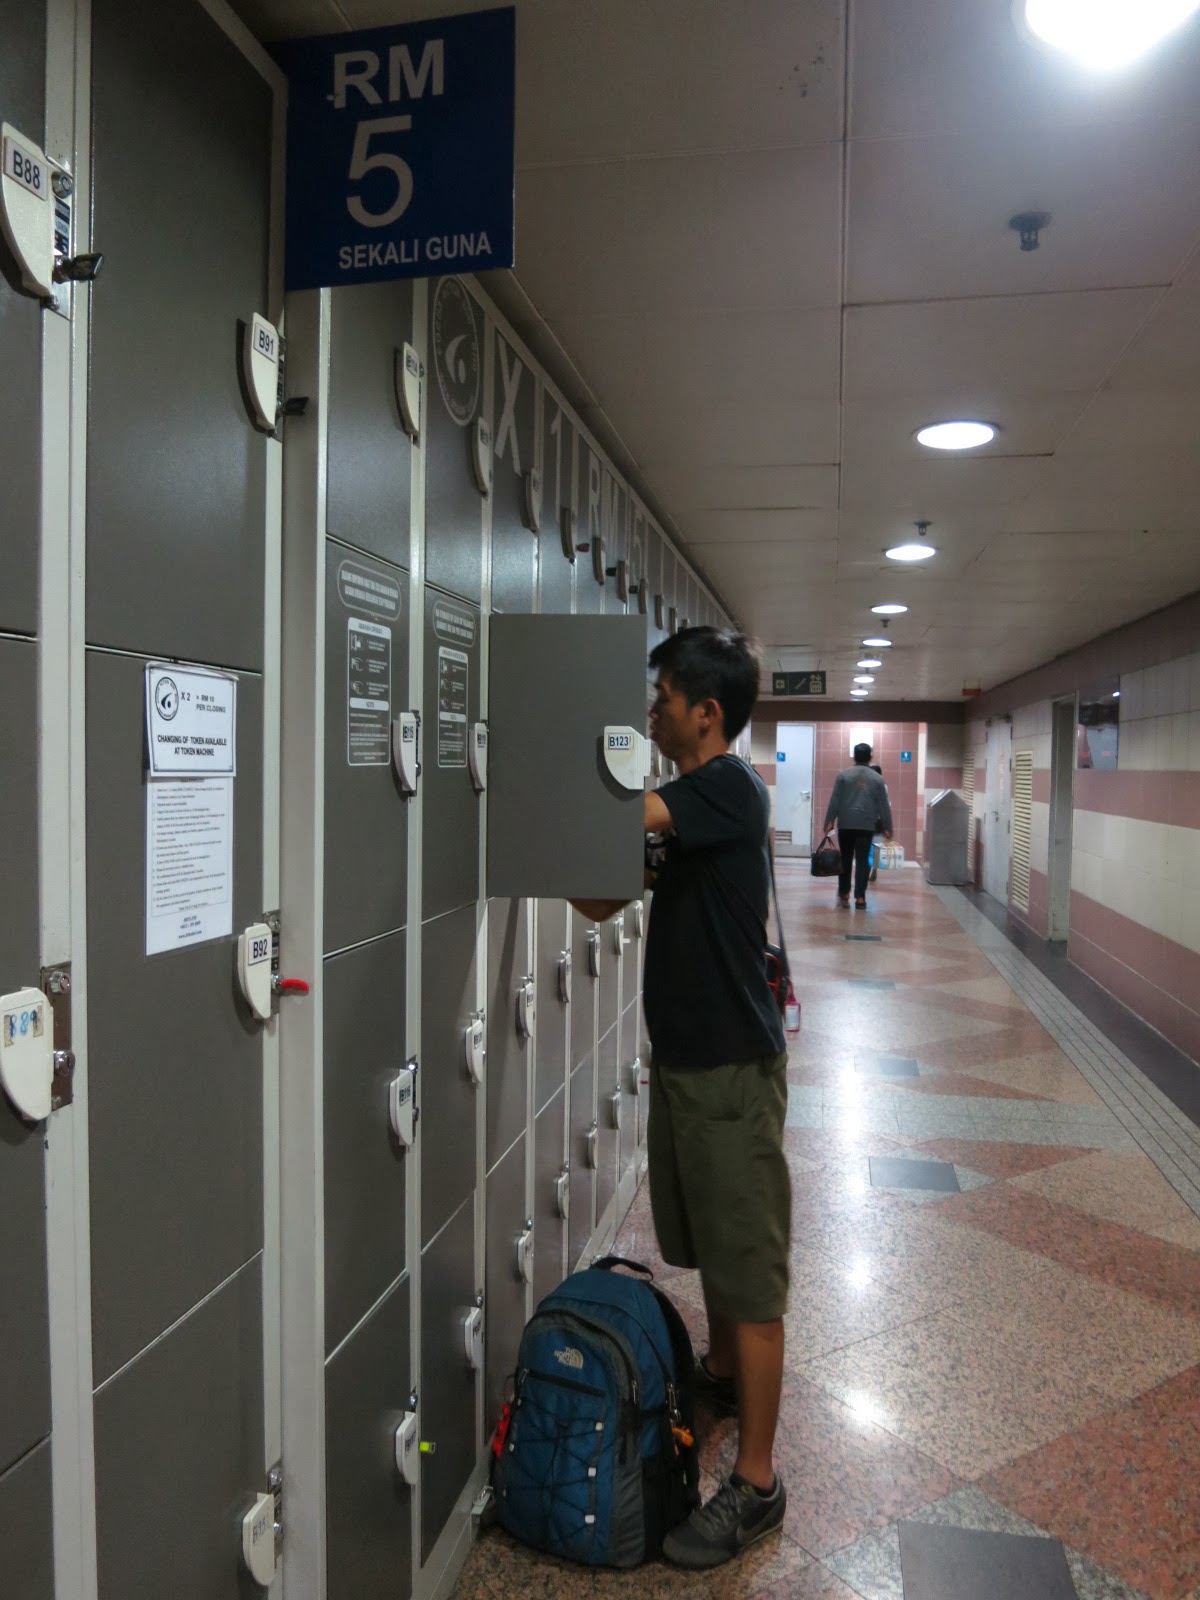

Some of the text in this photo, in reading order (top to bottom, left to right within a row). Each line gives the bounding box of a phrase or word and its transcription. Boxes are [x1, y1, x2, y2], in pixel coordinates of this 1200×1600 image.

[333, 38, 445, 109] RM
[13, 149, 41, 190] B88
[346, 114, 414, 229] 5
[338, 231, 492, 270] SEKALI GUNA
[259, 329, 274, 355] B91
[181, 692, 186, 701] X
[187, 692, 191, 701] 2
[201, 694, 208, 702] RM
[196, 703, 226, 713] PER CLOSING
[157, 734, 227, 746] CHANGING OF TOKEN AVAILABLE
[608, 736, 630, 748] B123
[181, 747, 196, 755] TOKEN
[196, 748, 215, 756] MACHINE
[252, 938, 269, 959] B92
